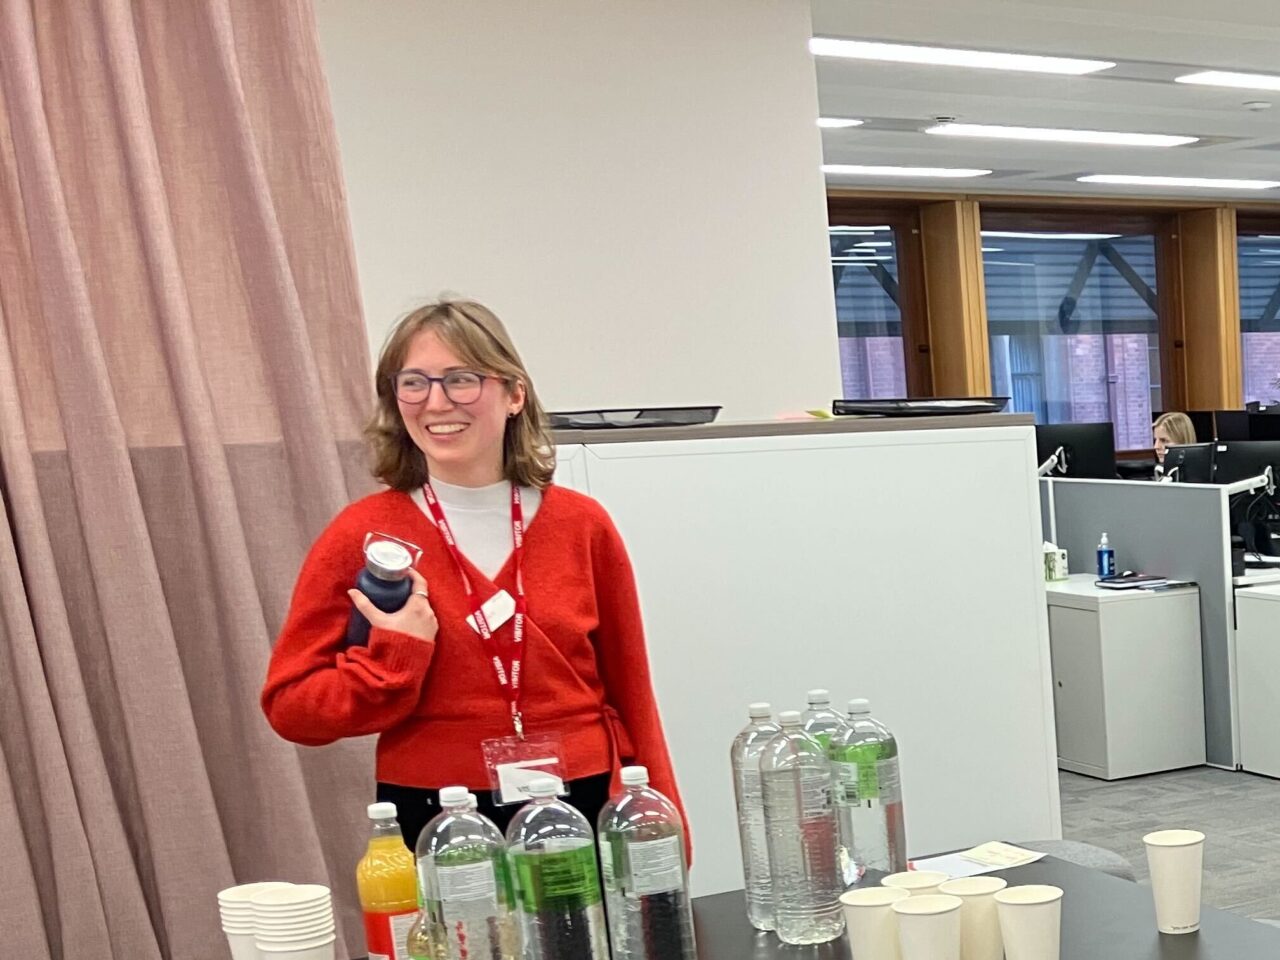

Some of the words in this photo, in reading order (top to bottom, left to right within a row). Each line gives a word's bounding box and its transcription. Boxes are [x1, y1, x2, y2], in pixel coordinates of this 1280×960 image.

[474, 609, 491, 640] VISITOR
[513, 613, 524, 643] VISITOR
[492, 655, 508, 685] VISITOR
[511, 660, 521, 689] VISITOR
